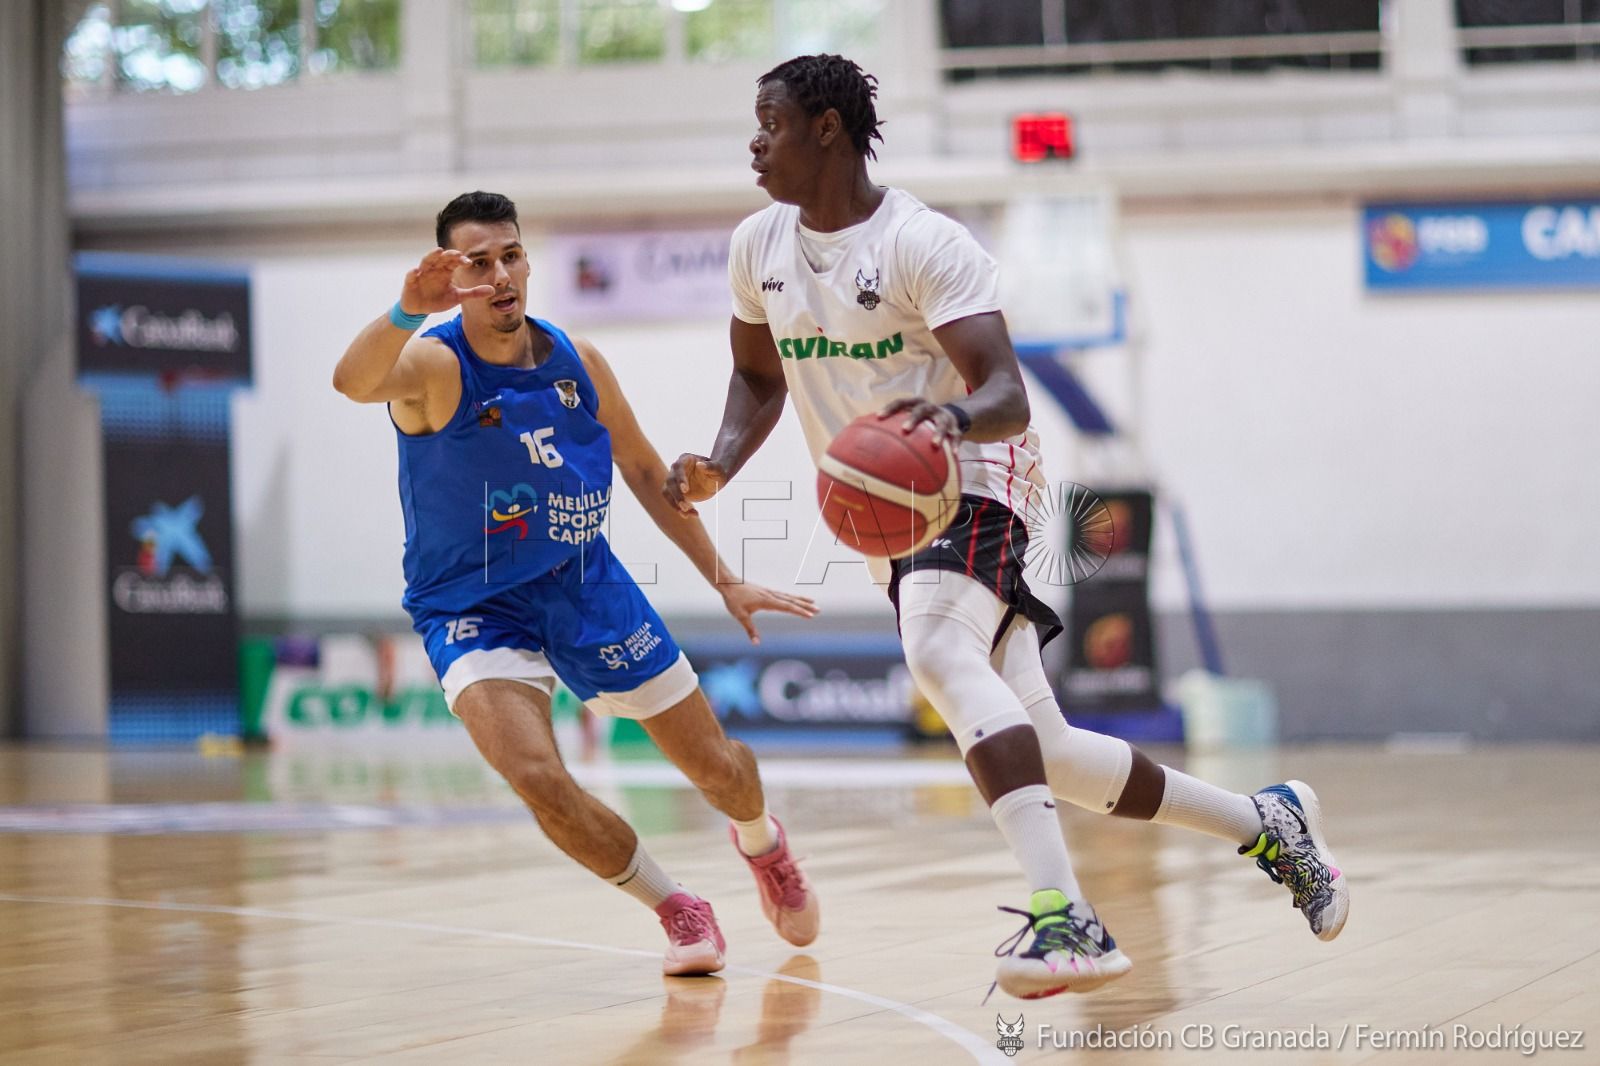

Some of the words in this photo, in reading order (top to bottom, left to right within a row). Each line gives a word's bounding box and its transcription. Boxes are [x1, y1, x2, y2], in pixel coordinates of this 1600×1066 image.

[520, 427, 563, 468] 16
[548, 526, 601, 545] CAPIT
[932, 538, 951, 549] ve
[445, 617, 483, 645] 16
